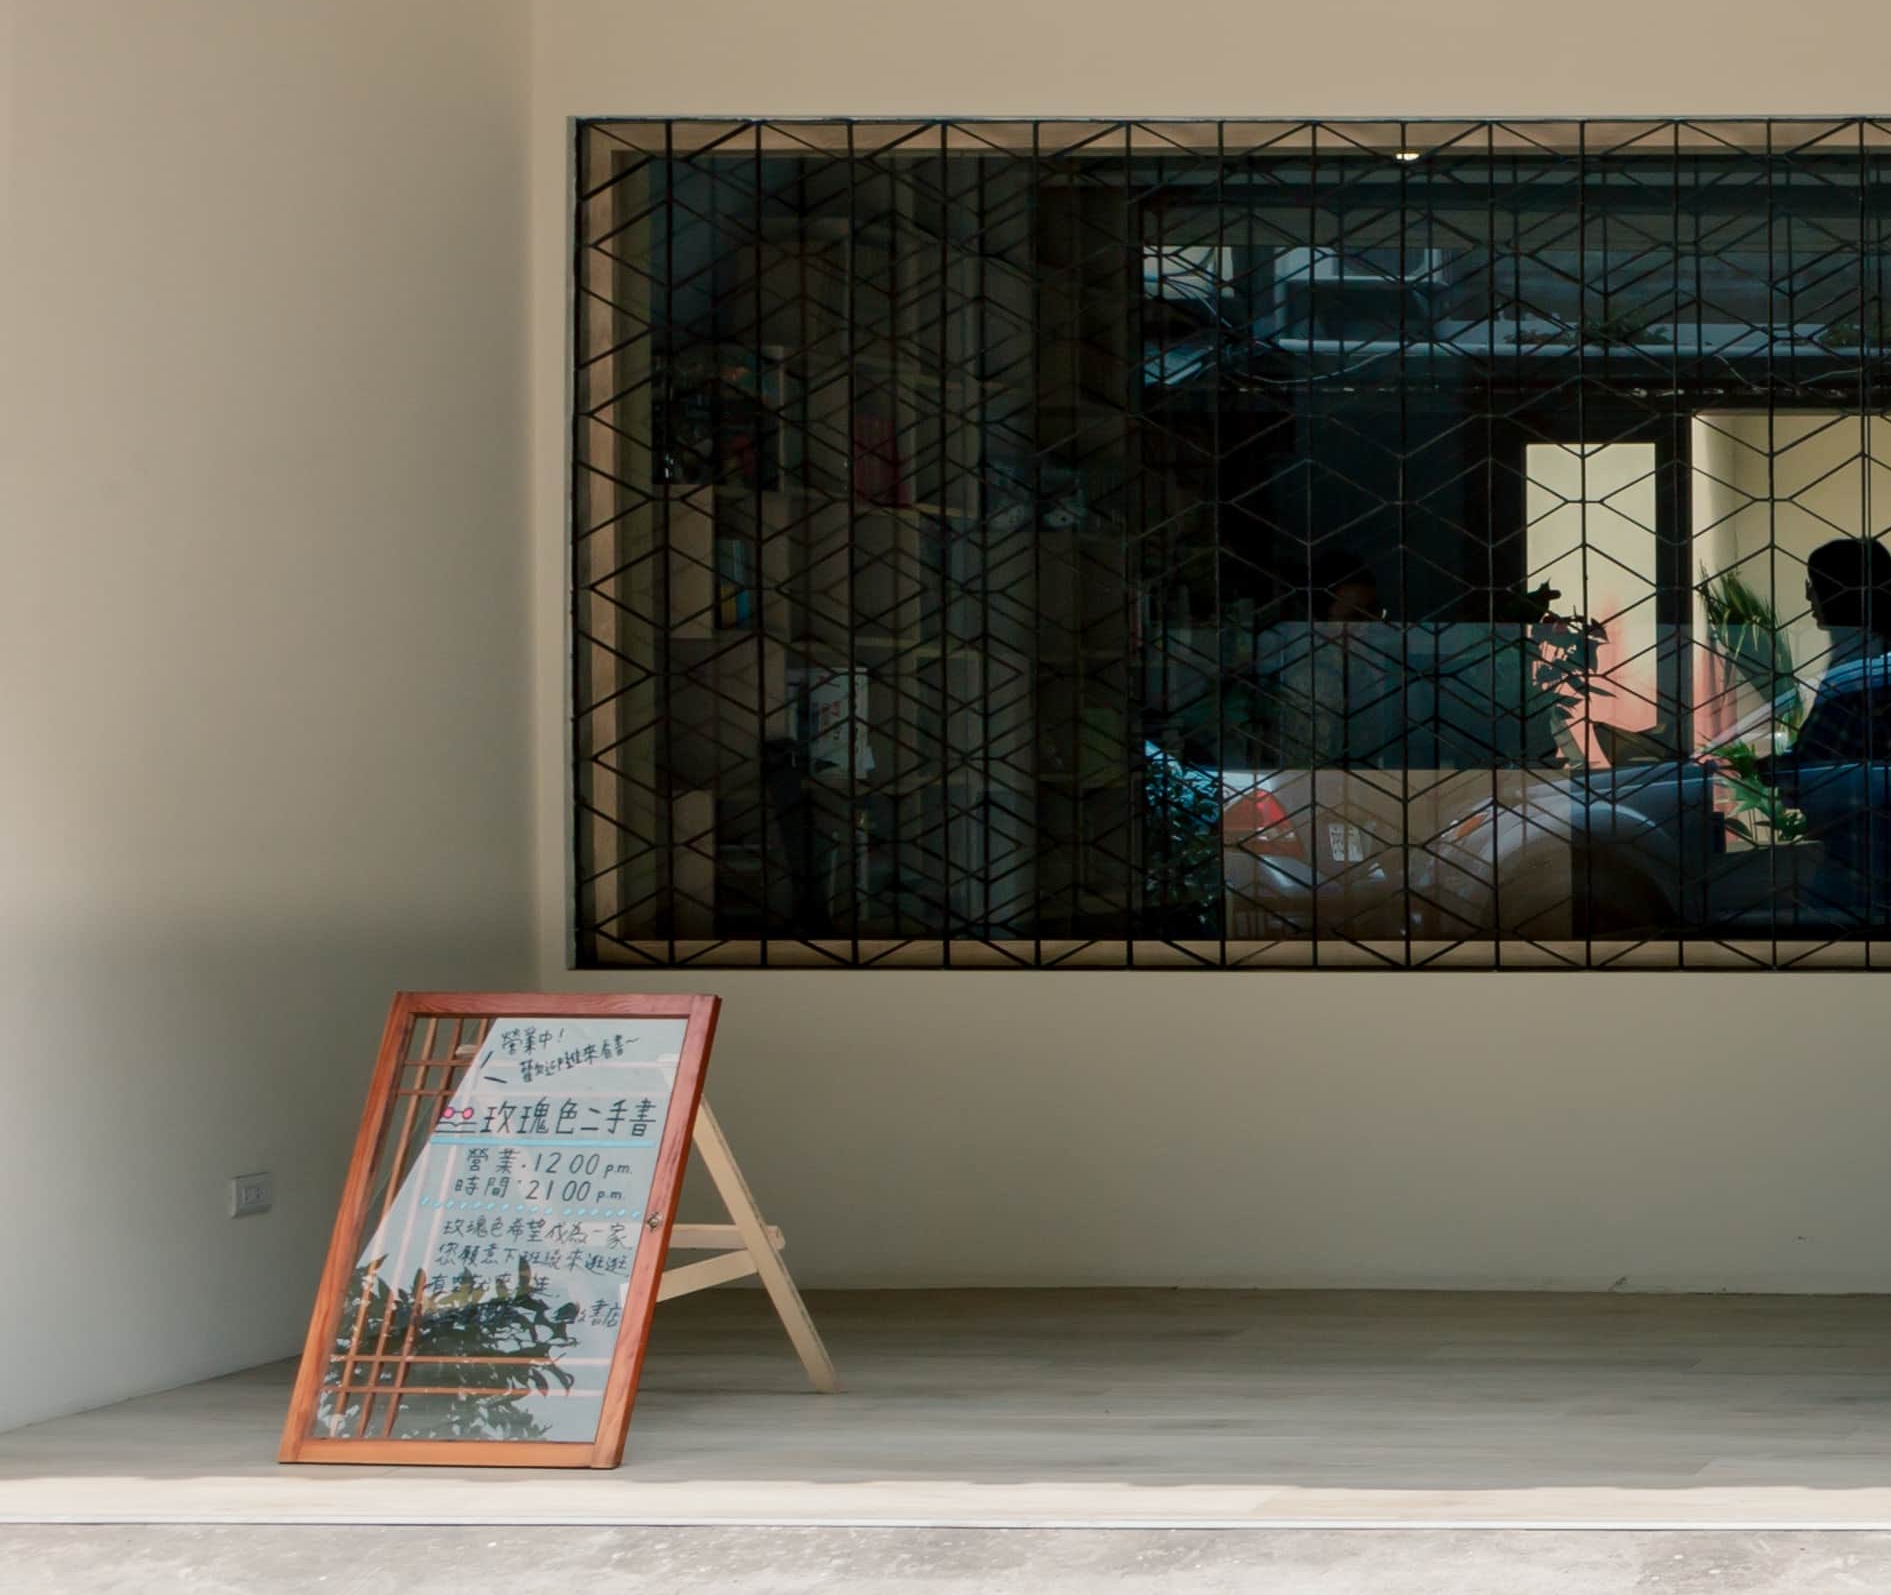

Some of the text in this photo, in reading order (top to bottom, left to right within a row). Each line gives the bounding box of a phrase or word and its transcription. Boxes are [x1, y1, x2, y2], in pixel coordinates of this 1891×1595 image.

[479, 1096, 657, 1137] 玫瑰色二手書
